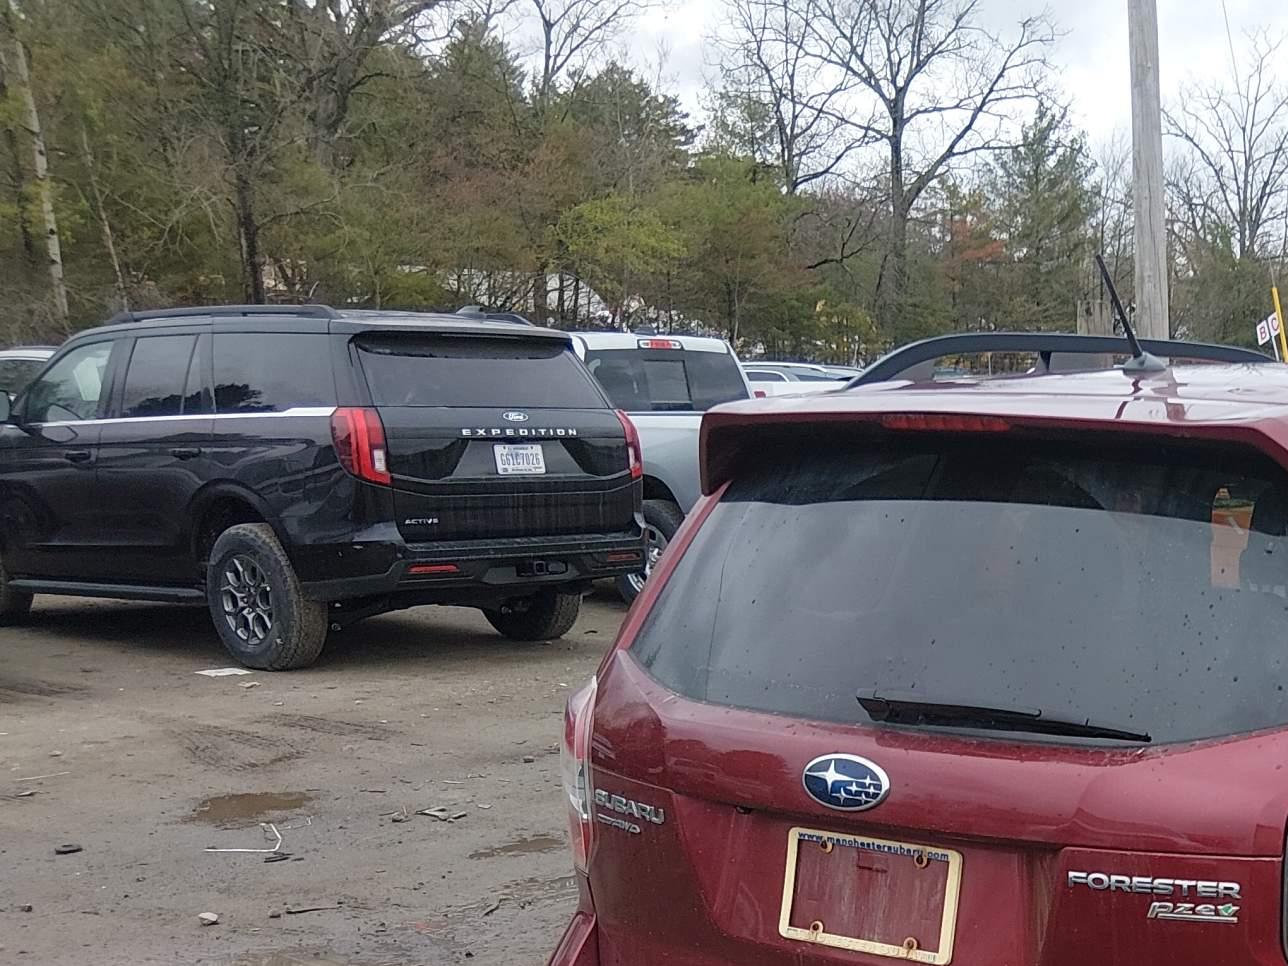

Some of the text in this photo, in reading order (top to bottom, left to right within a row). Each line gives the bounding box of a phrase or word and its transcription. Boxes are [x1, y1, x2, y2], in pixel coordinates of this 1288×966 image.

[461, 428, 577, 436] EXPEDITION
[595, 788, 665, 824] SUBARU
[1067, 870, 1242, 899] FORESTER
